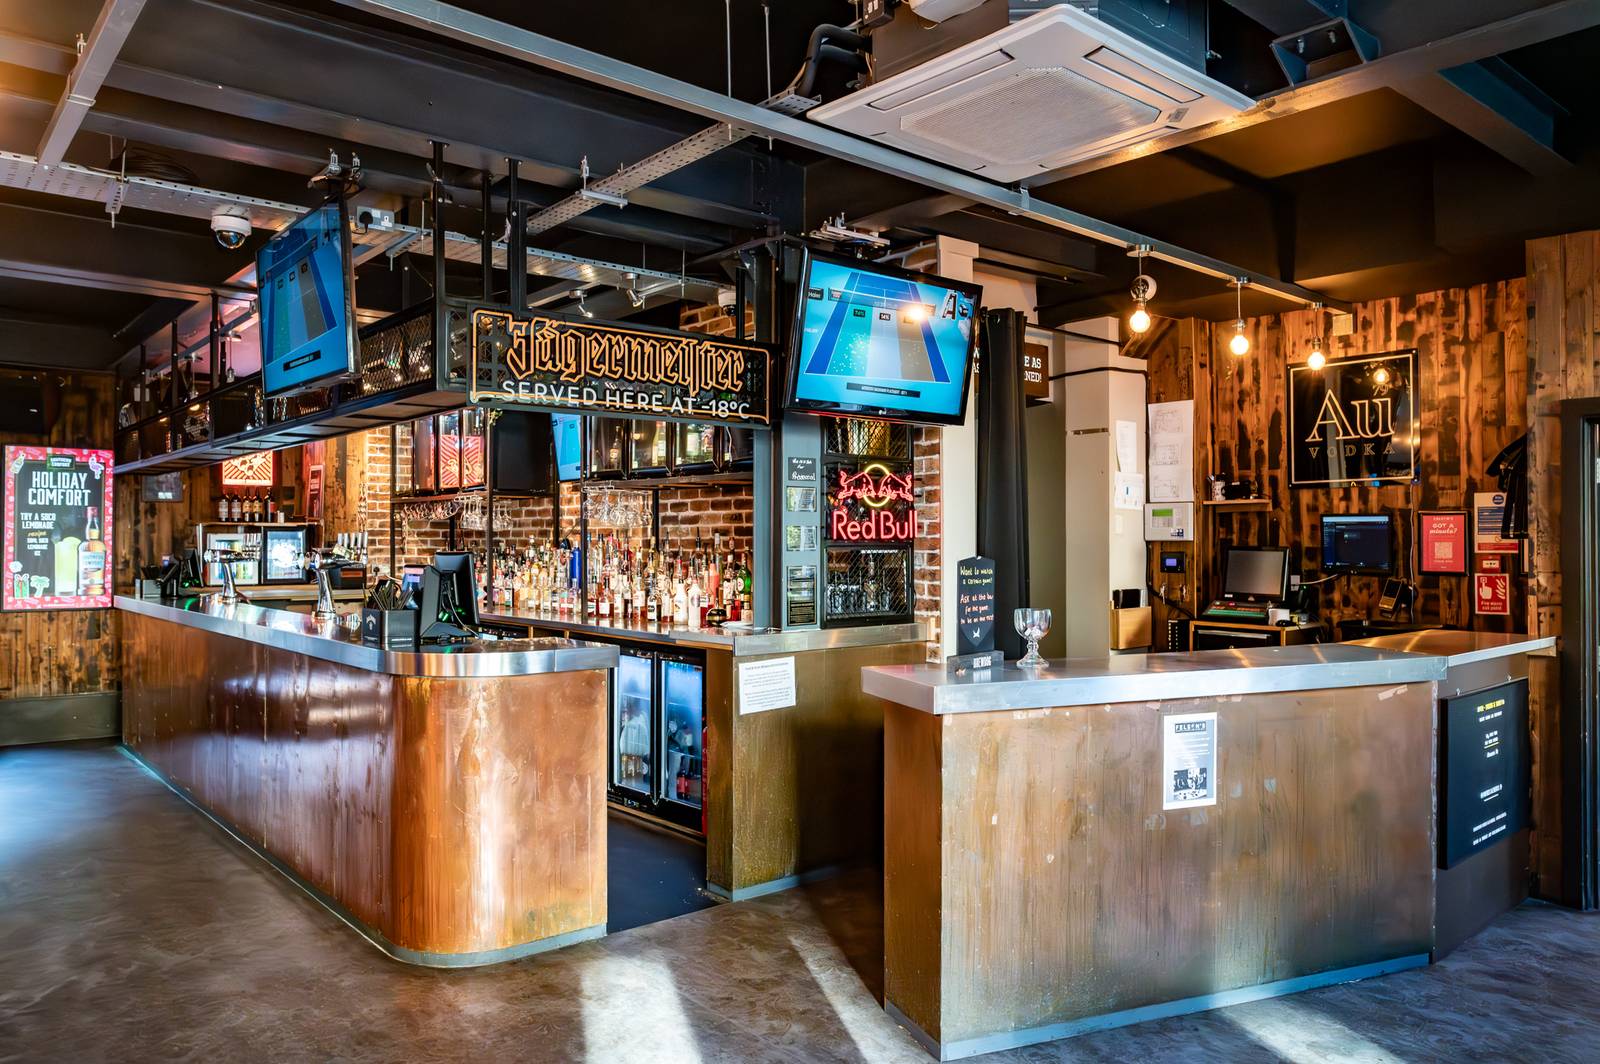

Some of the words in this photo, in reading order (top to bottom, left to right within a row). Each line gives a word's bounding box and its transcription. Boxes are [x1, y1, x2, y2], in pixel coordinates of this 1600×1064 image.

[1031, 357, 1042, 369] AS
[1024, 370, 1042, 383] NED!
[502, 380, 597, 406] SERVED
[605, 389, 663, 412] HERE
[670, 396, 696, 415] AT
[1305, 388, 1395, 442] Au
[1309, 442, 1396, 459] VODKA
[32, 471, 88, 489] HOLIDAY
[28, 488, 91, 506] COMFORT
[34, 512, 39, 520] A
[833, 510, 875, 540] Red
[880, 510, 918, 539] Bull
